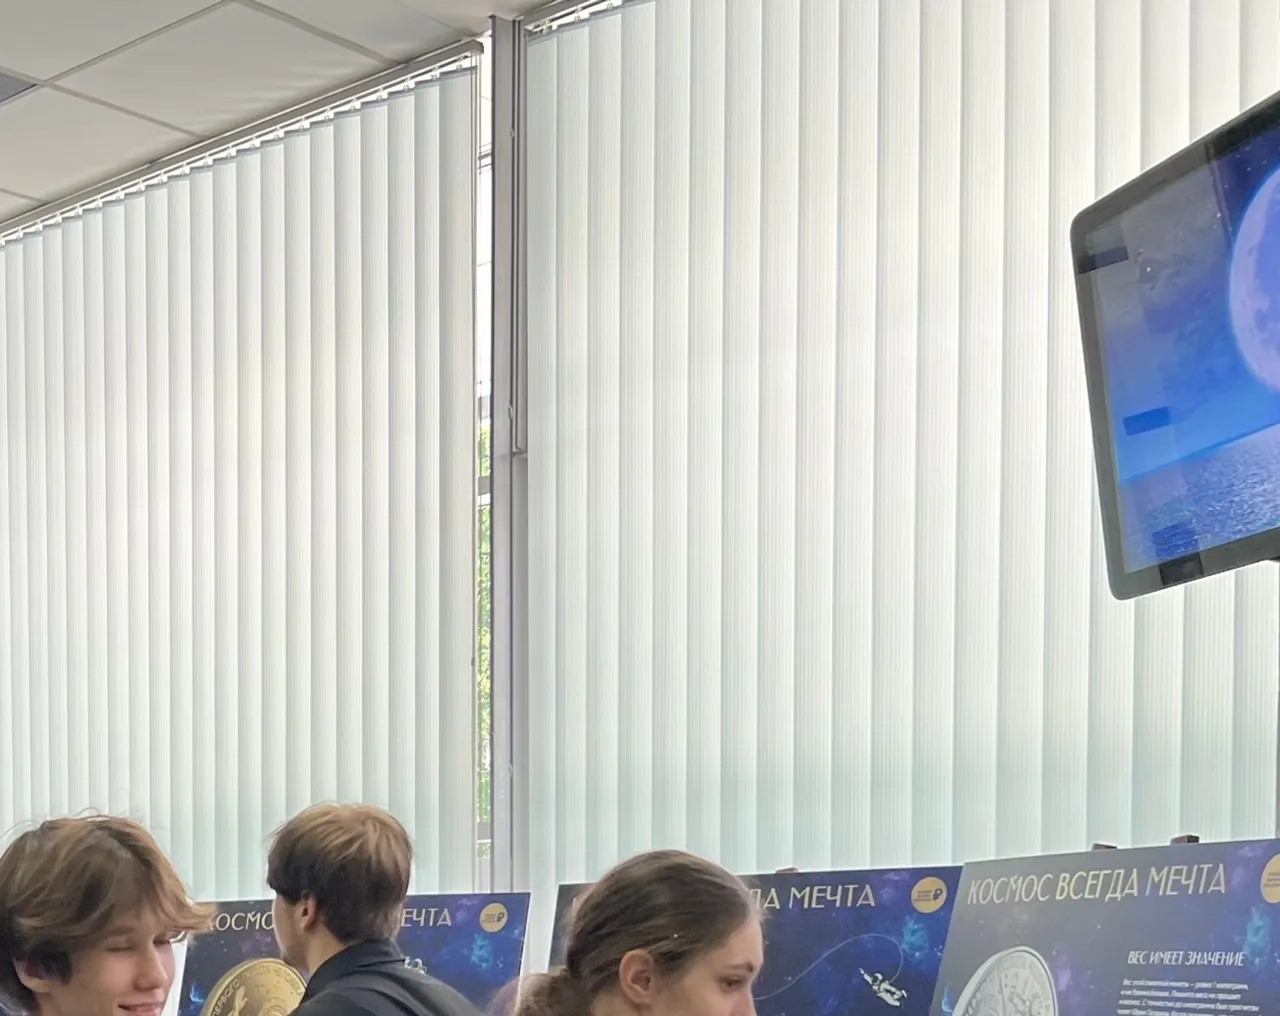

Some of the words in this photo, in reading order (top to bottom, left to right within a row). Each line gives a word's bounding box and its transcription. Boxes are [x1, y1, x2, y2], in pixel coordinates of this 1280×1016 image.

[967, 873, 1053, 905] КОСМОС
[1055, 868, 1138, 902] ВСЕГДА
[1146, 863, 1227, 897] МЕЧТА
[789, 884, 876, 909] МЕЧТА
[209, 911, 274, 931] ОСМО
[401, 908, 452, 927] ЕЧТА
[1127, 951, 1148, 965] ВЕС
[1149, 951, 1184, 966] ИМЕЕТ
[1185, 951, 1247, 967] ЗНАЧЕНИЕ
